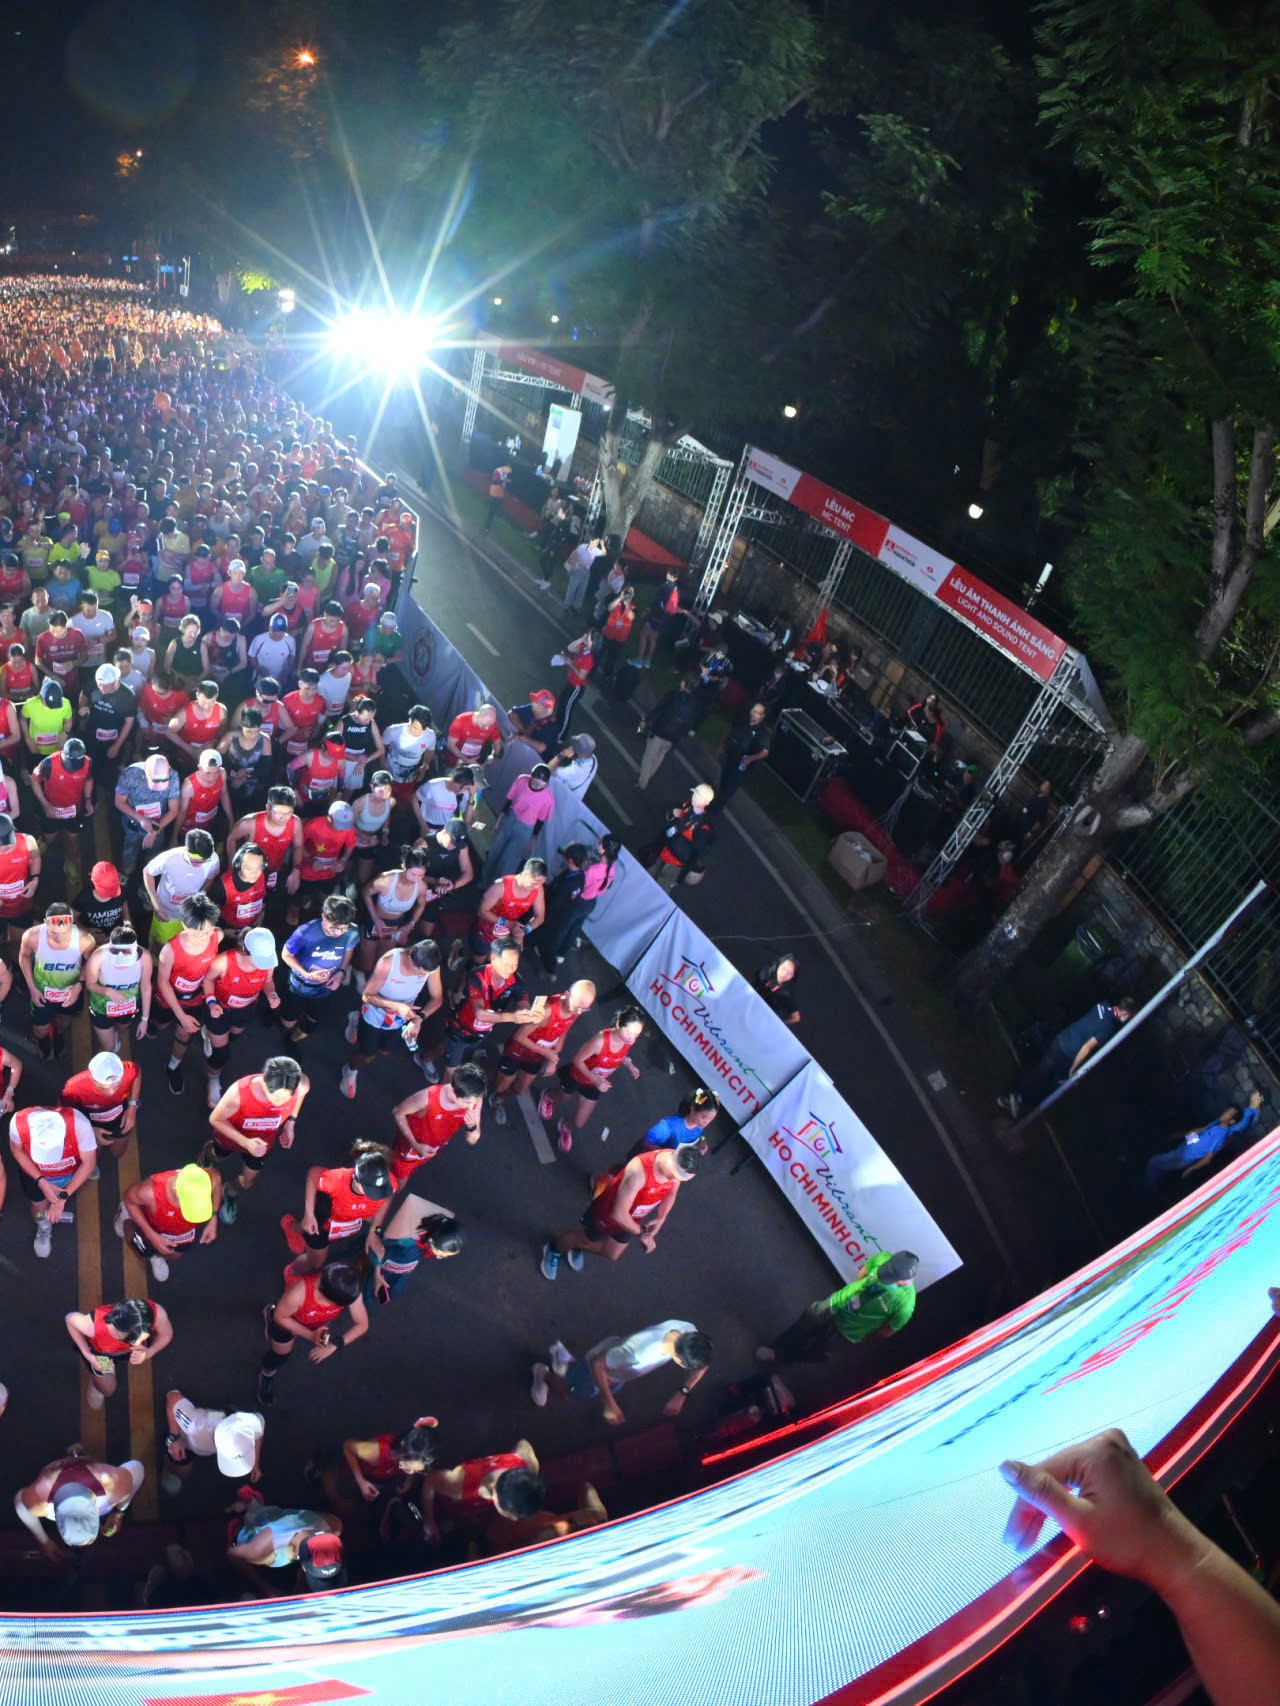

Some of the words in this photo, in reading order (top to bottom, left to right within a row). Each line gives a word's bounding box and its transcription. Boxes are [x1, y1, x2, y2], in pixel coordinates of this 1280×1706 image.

[821, 510, 834, 522] MC
[833, 517, 851, 532] TENT
[841, 508, 856, 522] MC
[957, 596, 977, 613] LIGHT
[977, 610, 993, 625] AND
[992, 622, 1019, 644] SOUND
[1018, 640, 1038, 658] TENT
[980, 599, 1011, 625] THANH
[1030, 635, 1057, 660] SÁNG
[650, 979, 672, 1007] HO
[671, 1005, 697, 1036] CHI
[694, 1032, 732, 1078] MINH
[728, 1075, 763, 1115] CITY
[768, 1131, 793, 1162] HO
[790, 1162, 818, 1196] CHI
[811, 1192, 851, 1243] MINH
[845, 1241, 867, 1270] CI
